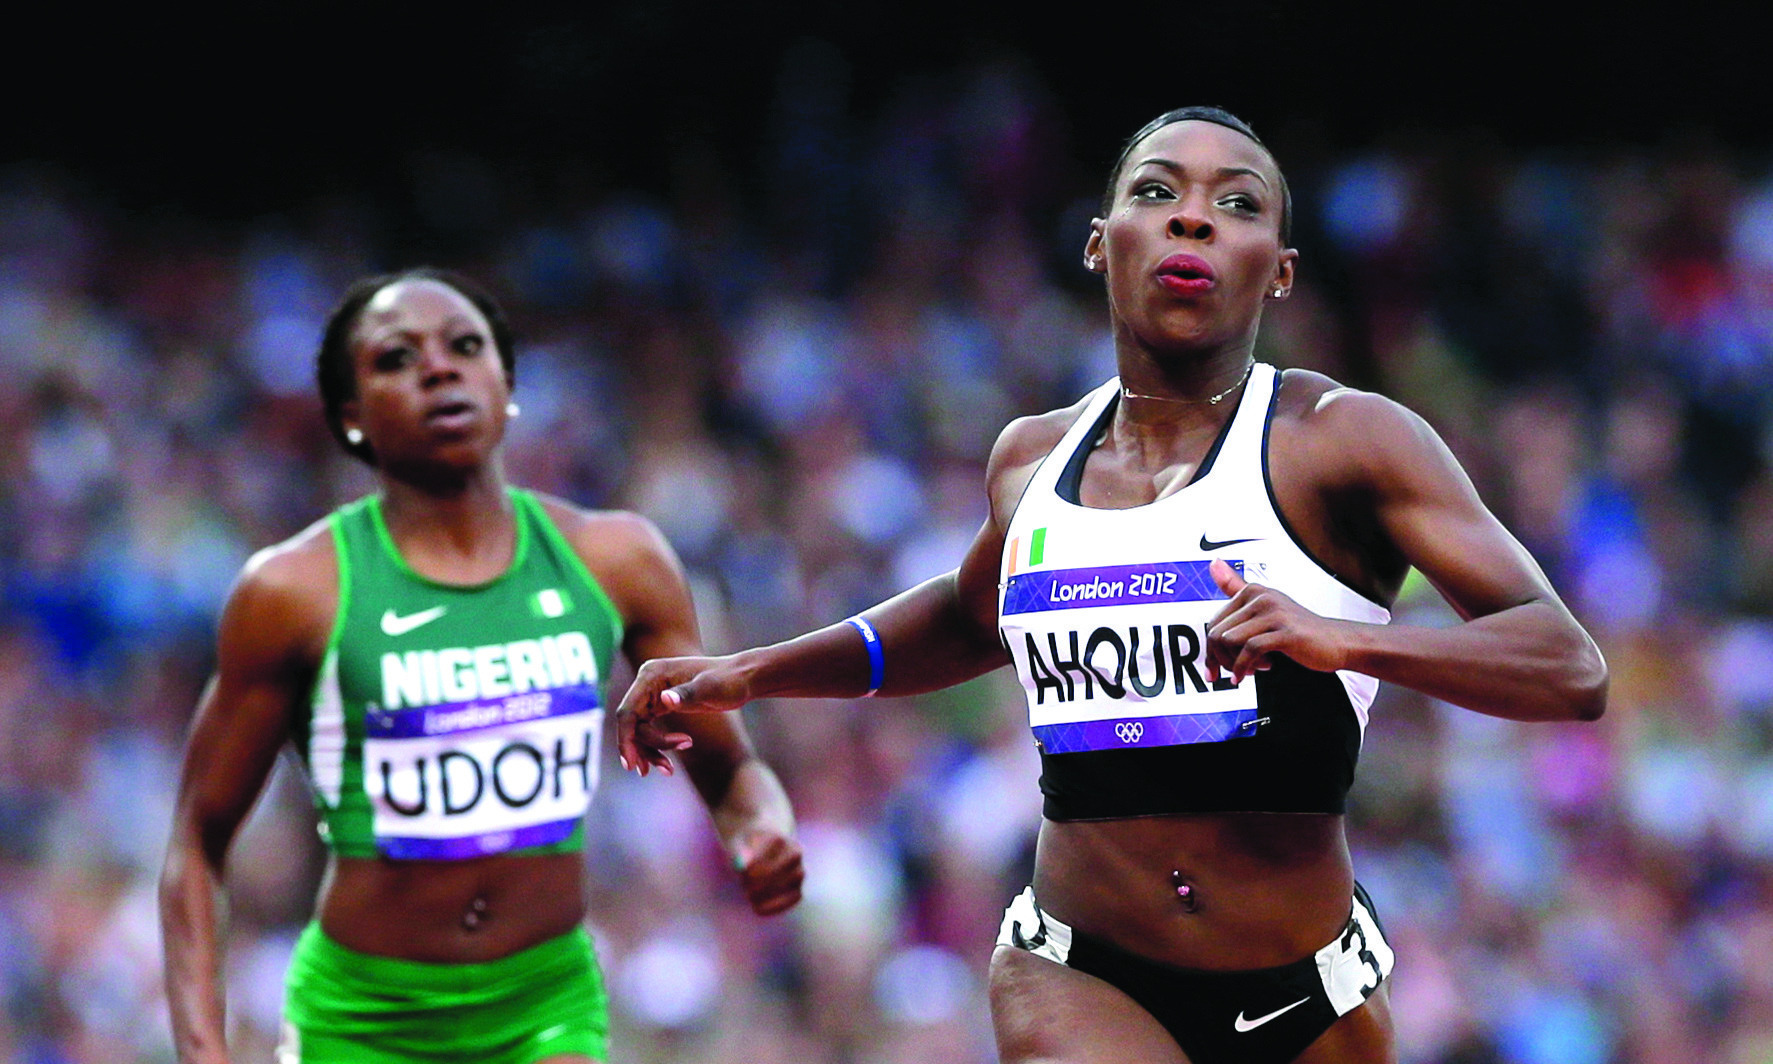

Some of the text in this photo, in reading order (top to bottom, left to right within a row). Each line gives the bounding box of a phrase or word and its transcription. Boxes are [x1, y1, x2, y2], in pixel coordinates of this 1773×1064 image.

[1050, 572, 1178, 602] London 2012
[380, 631, 598, 710] NIGERIA
[380, 732, 592, 817] UDOH
[1341, 918, 1383, 1000] 3
